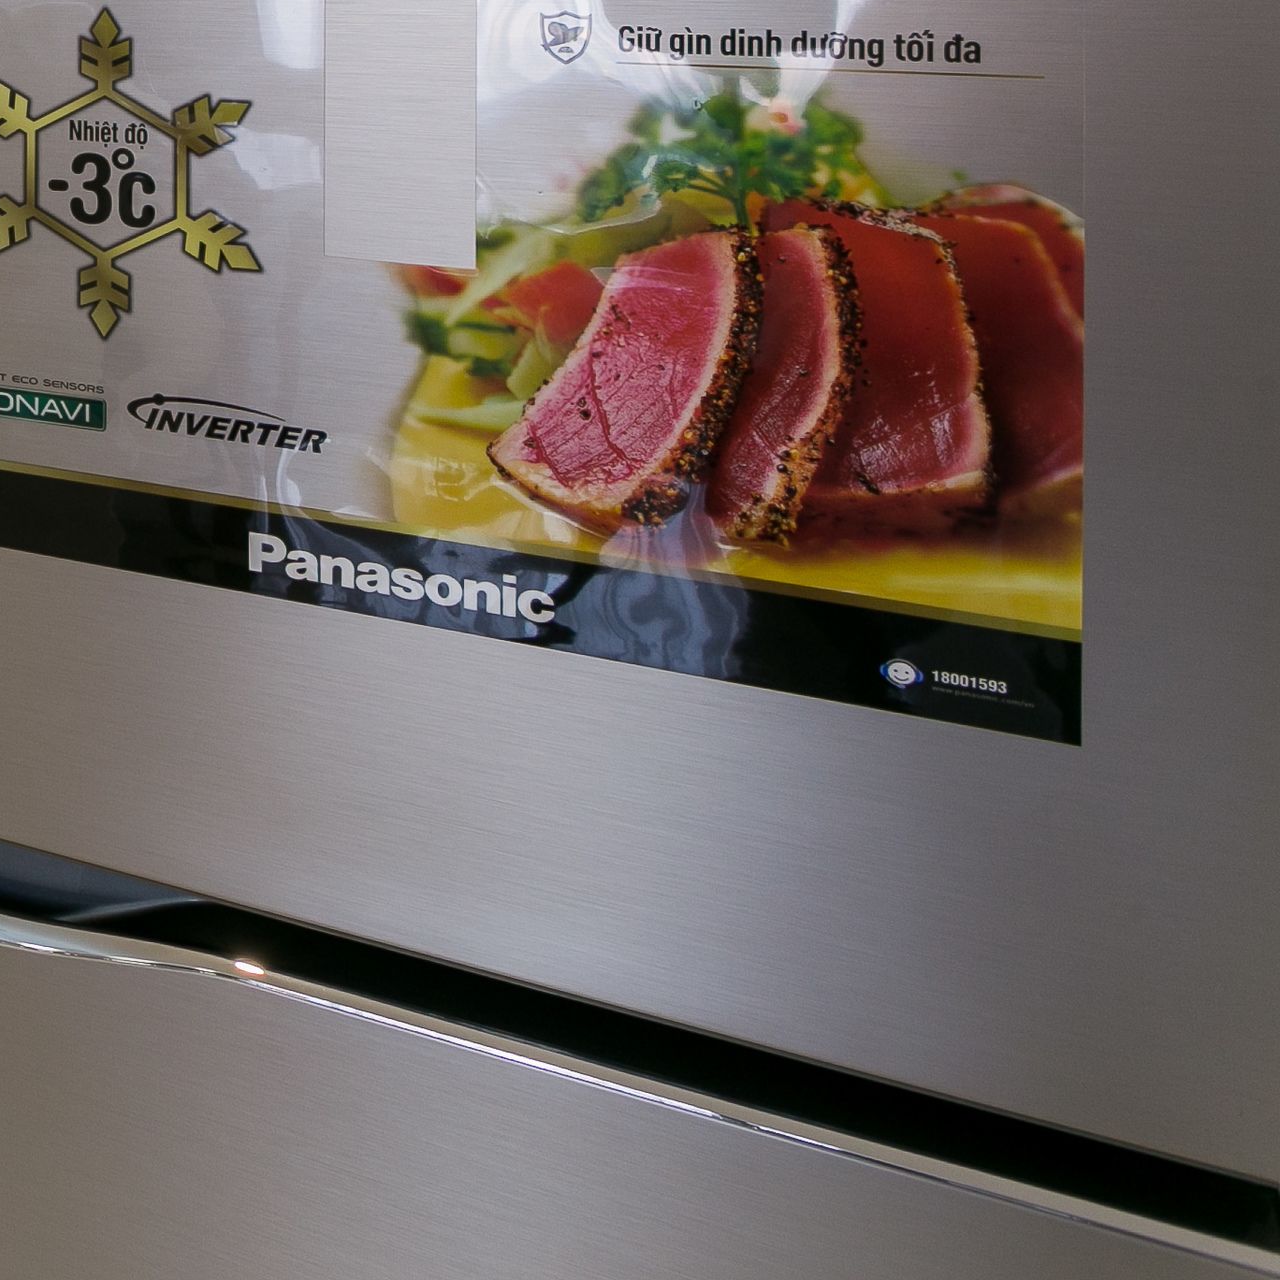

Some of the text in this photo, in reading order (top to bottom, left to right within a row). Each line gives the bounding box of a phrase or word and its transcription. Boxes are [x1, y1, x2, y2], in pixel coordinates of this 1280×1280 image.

[618, 24, 983, 66] Giữ gìn dinh dưỡng tối đa
[69, 119, 149, 150] Nhiệt độ
[10, 374, 39, 386] ECO
[42, 379, 105, 395] SENSORS
[137, 404, 329, 455] INVERTER
[247, 531, 556, 624] Panasonic
[931, 670, 1008, 694] 18001593
